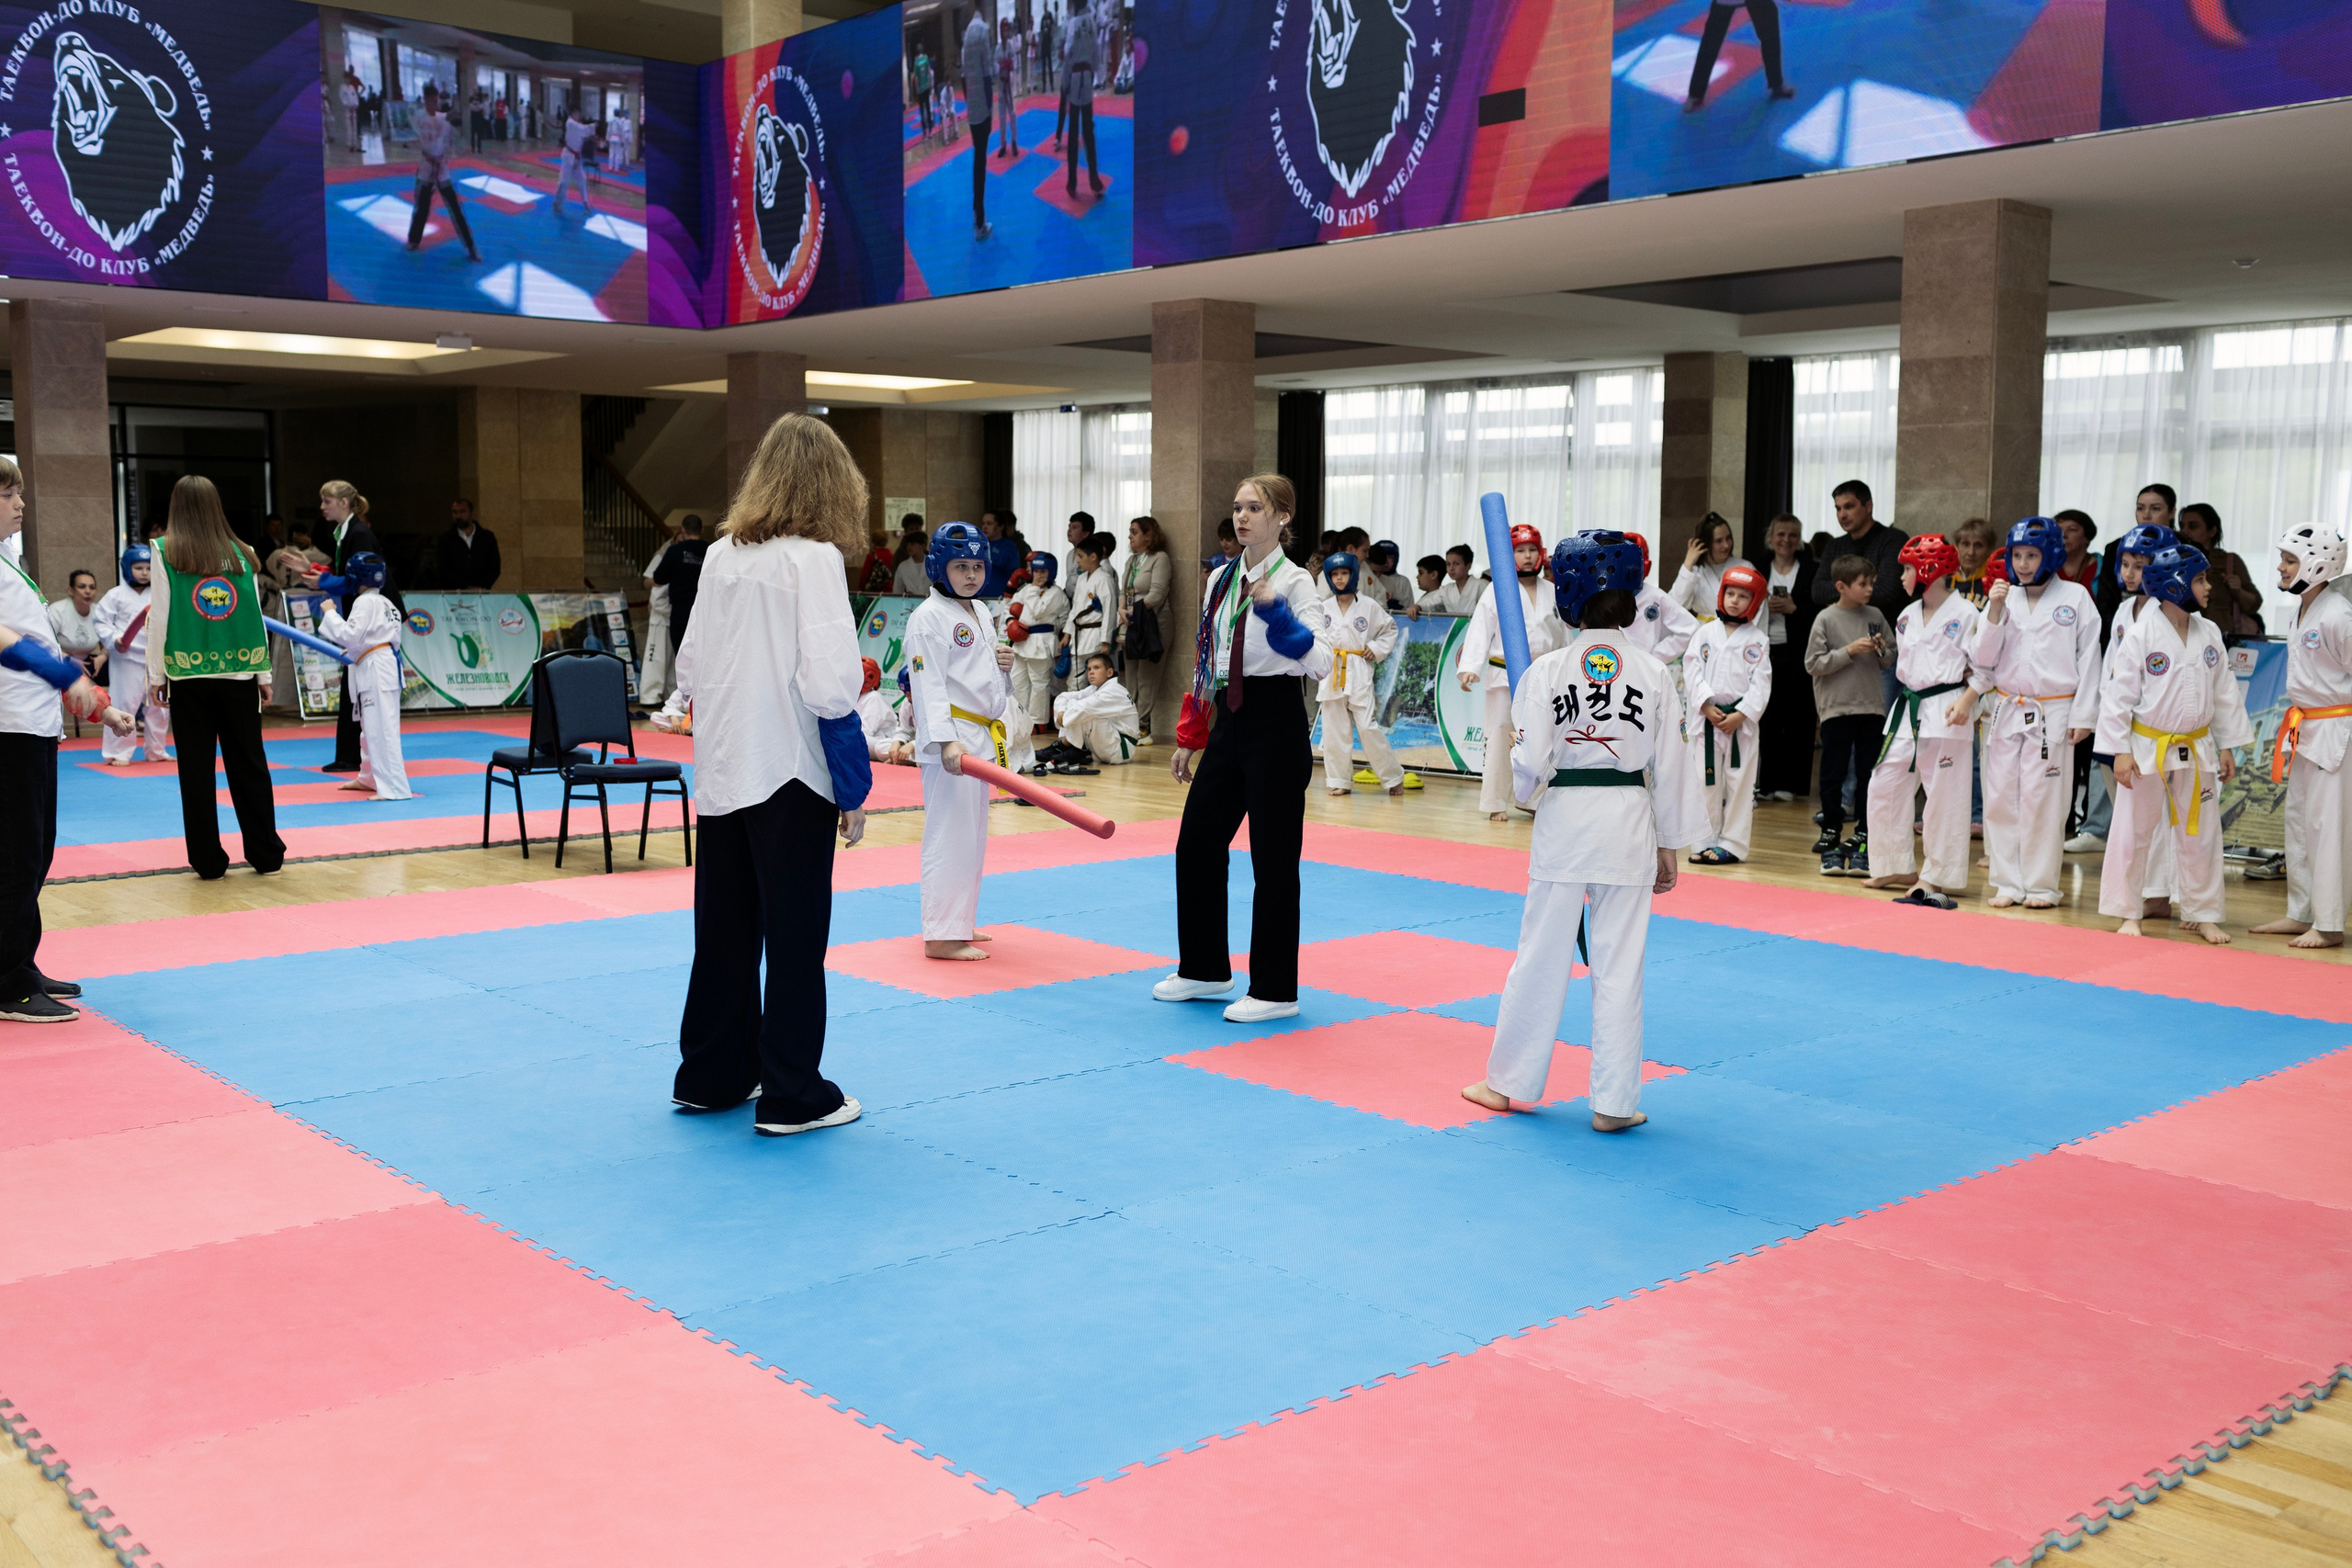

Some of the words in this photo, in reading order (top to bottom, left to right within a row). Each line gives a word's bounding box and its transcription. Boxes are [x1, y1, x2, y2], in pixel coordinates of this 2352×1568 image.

[0, 0, 84, 102] ТАЕКВОН-ДО
[89, 0, 141, 24] КЛУБ
[1270, 107, 1334, 224] ТАЕКВОН-ДО
[1338, 199, 1379, 227] КЛУБ
[4, 152, 96, 268] ТАЕКВОН-ДО
[100, 257, 150, 275] КЛУБ
[447, 671, 510, 685] ЖЕЛЕЗНОВОДСК
[1552, 683, 1645, 732] 태권도
[997, 742, 1007, 768] TAEKWO
